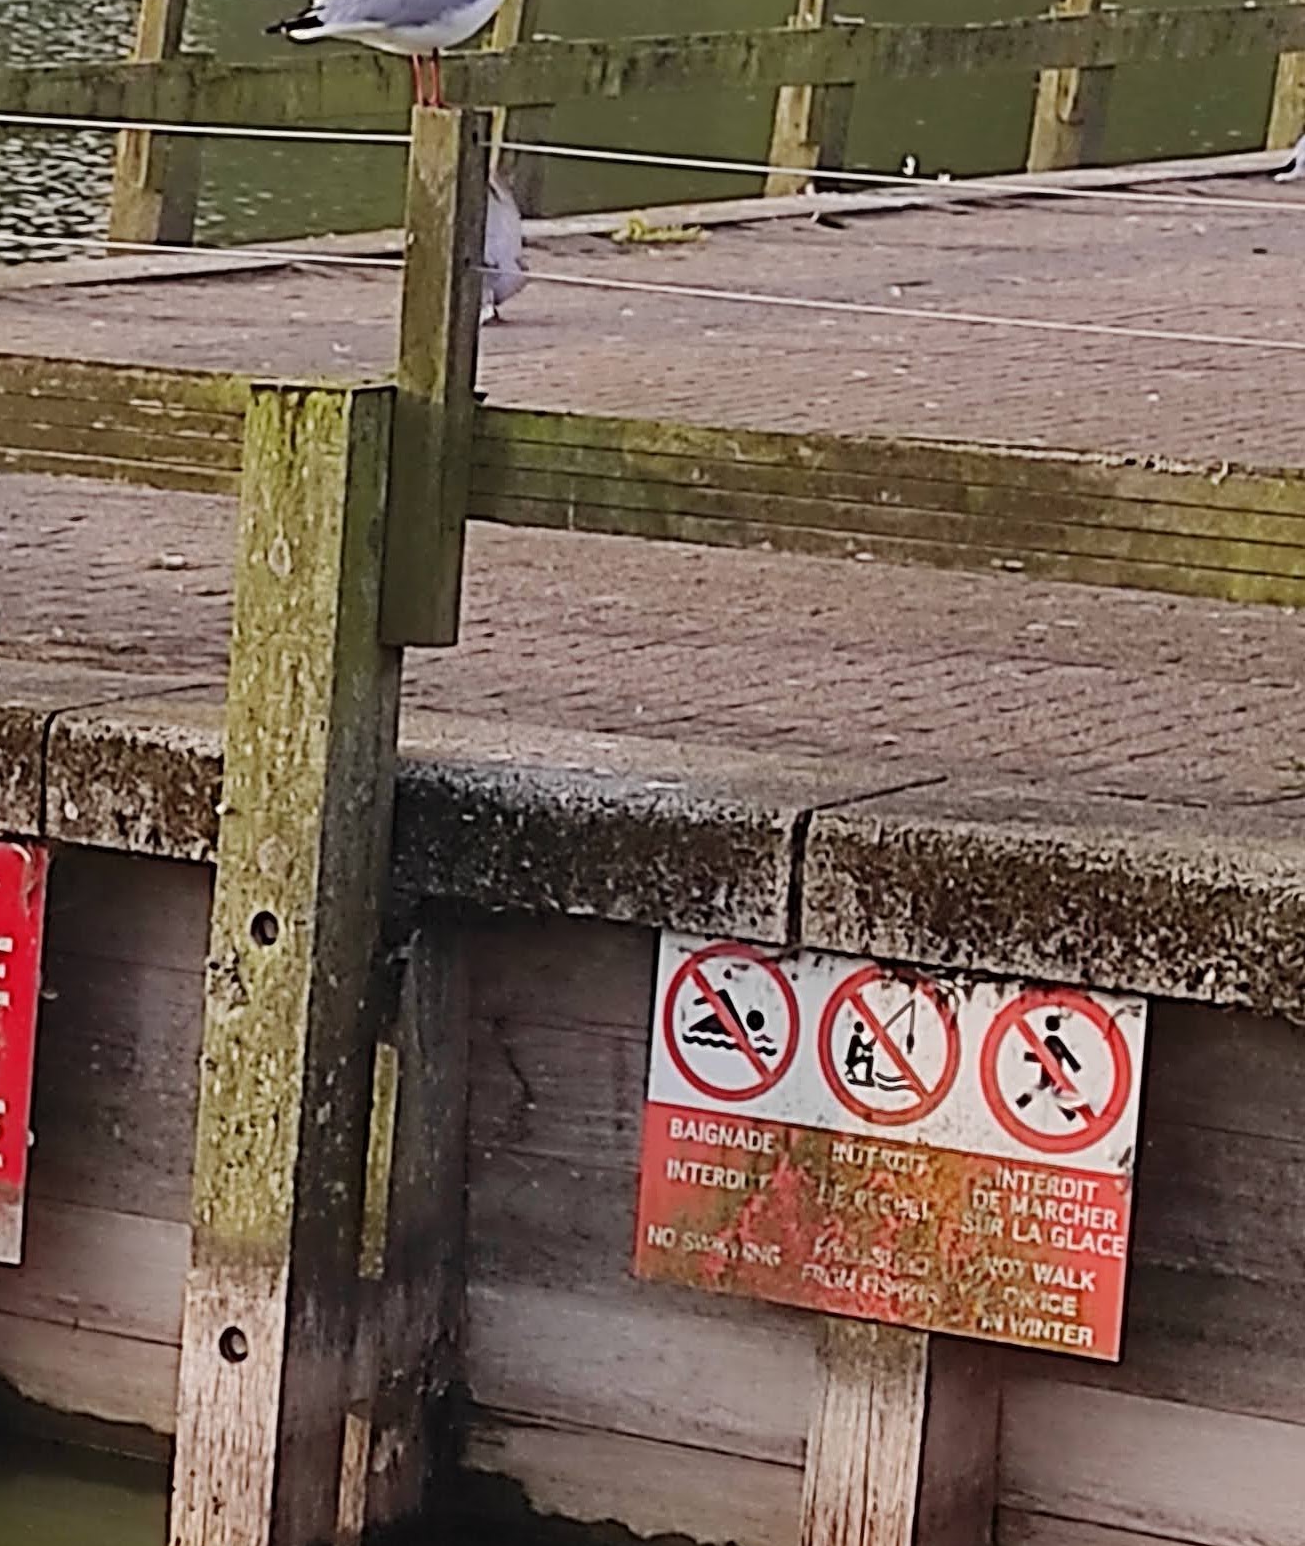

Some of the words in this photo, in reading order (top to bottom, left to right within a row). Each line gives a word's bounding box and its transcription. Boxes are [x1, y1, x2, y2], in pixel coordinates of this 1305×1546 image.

[669, 1117, 776, 1154] BAIGNADE
[996, 1166, 1099, 1202] INTERDIT
[972, 1189, 1002, 1213] DE
[1010, 1195, 1118, 1230] MARCHER
[647, 1224, 676, 1248] NO
[961, 1212, 1004, 1238] SUR
[1012, 1219, 1042, 1245] LA
[1050, 1226, 1125, 1258] GLACE
[1033, 1262, 1096, 1292] WALK
[1040, 1293, 1077, 1317] ICE
[1009, 1315, 1094, 1348] WINTER
